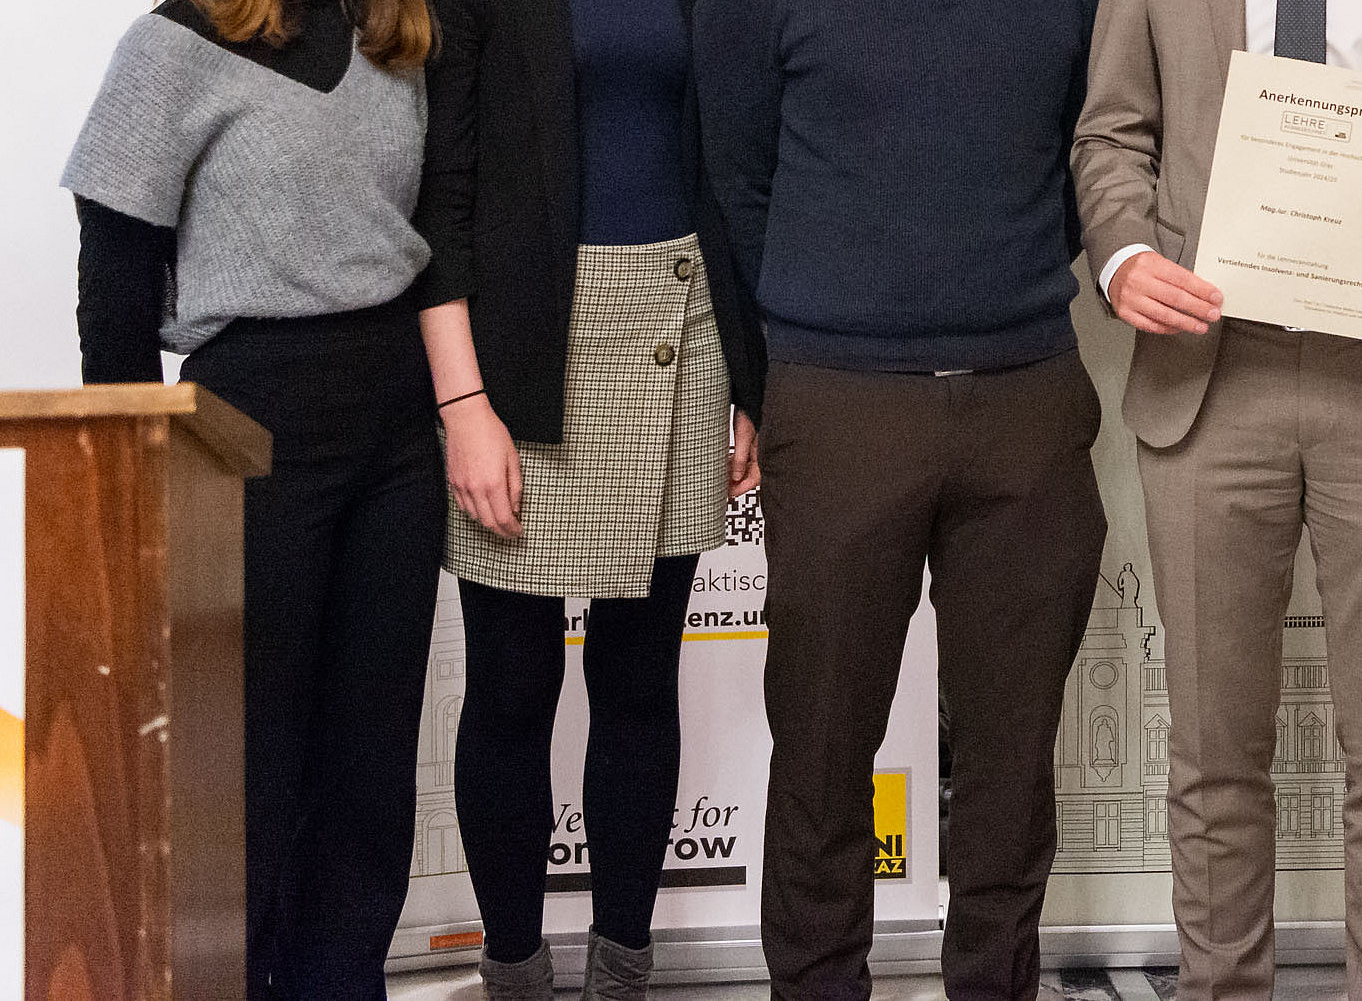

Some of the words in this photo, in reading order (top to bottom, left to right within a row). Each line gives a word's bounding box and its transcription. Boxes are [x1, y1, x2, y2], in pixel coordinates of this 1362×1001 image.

[1285, 114, 1325, 130] LEHRE
[683, 796, 739, 834] for
[874, 834, 903, 857] NI
[874, 859, 903, 874] AZ
